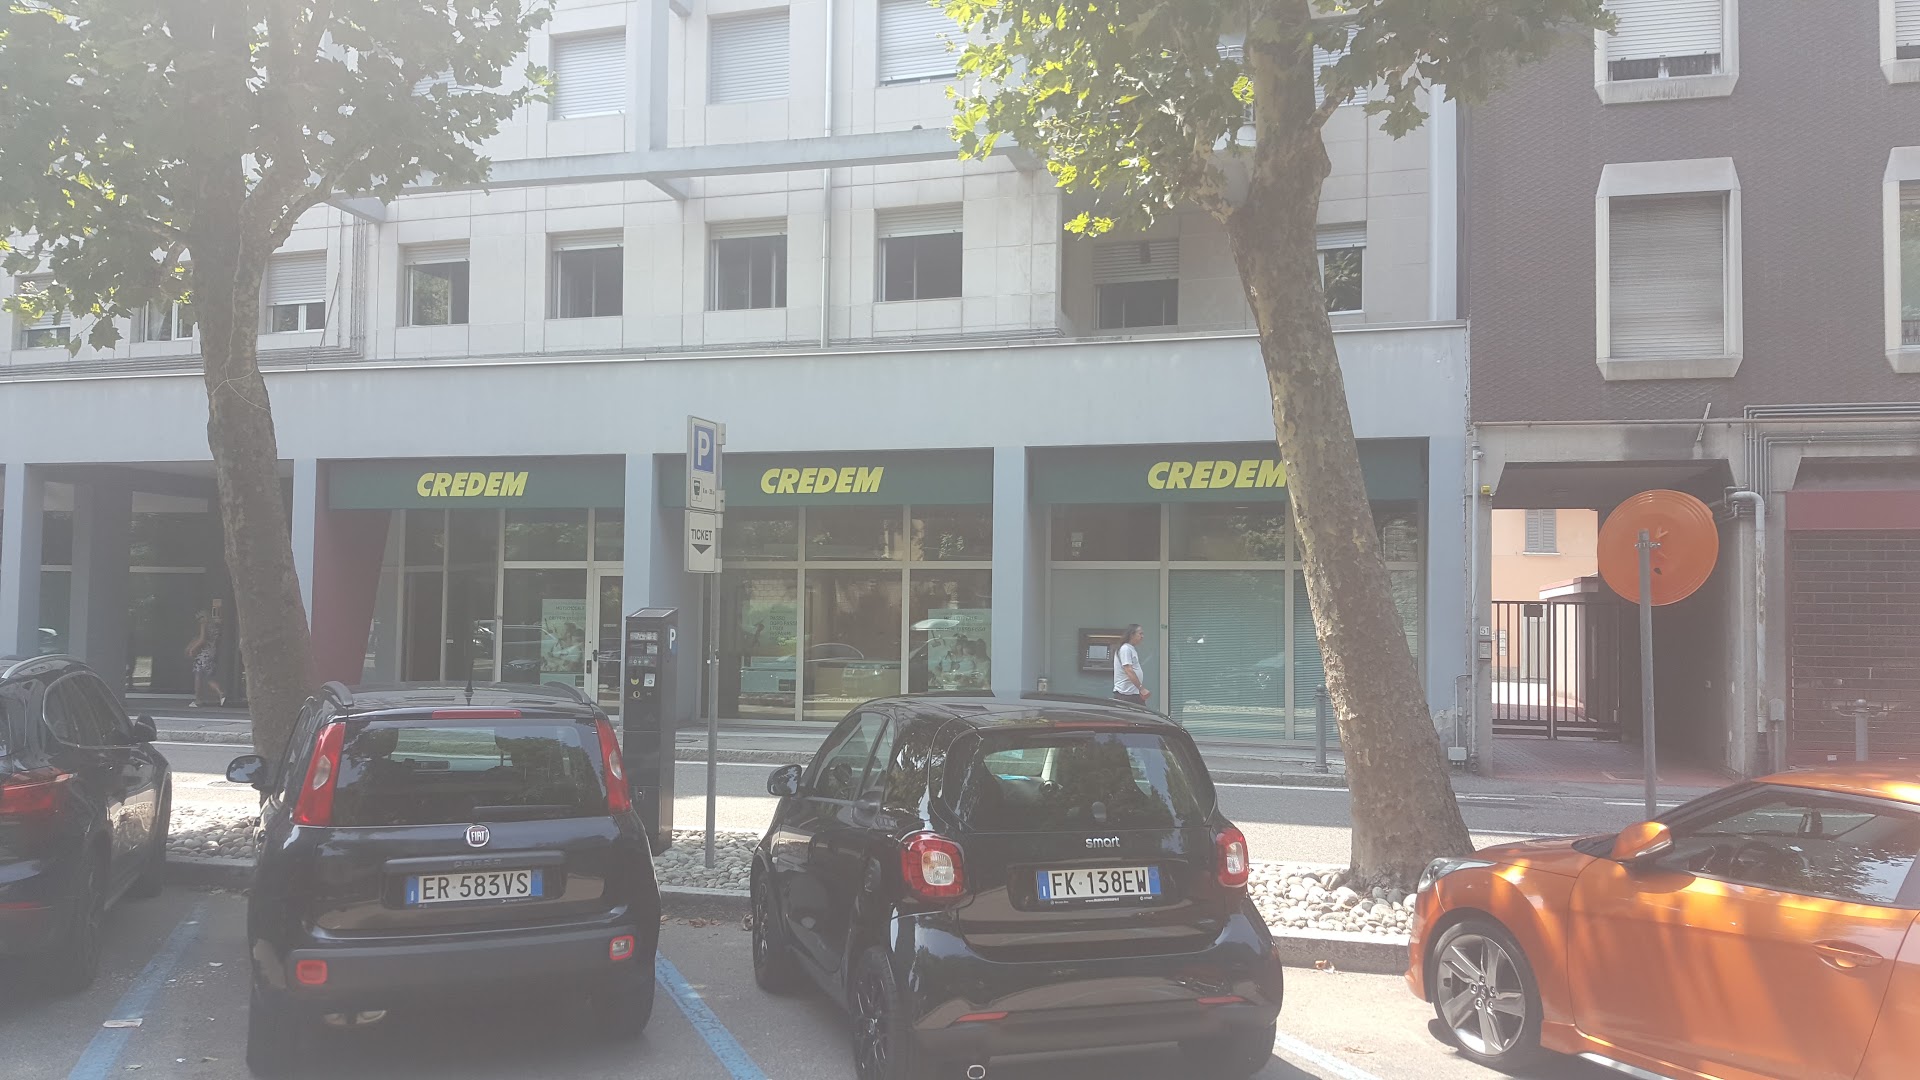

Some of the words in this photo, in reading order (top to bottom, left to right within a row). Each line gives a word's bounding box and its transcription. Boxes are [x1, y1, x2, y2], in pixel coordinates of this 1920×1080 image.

[697, 430, 711, 467] P
[416, 471, 529, 497] CREDEM
[760, 466, 884, 494] CREDEM
[1147, 460, 1288, 489] CREDEM
[690, 528, 713, 542] TICKET
[1480, 627, 1489, 635] 51
[470, 830, 486, 842] FIAT
[1085, 836, 1121, 849] smart
